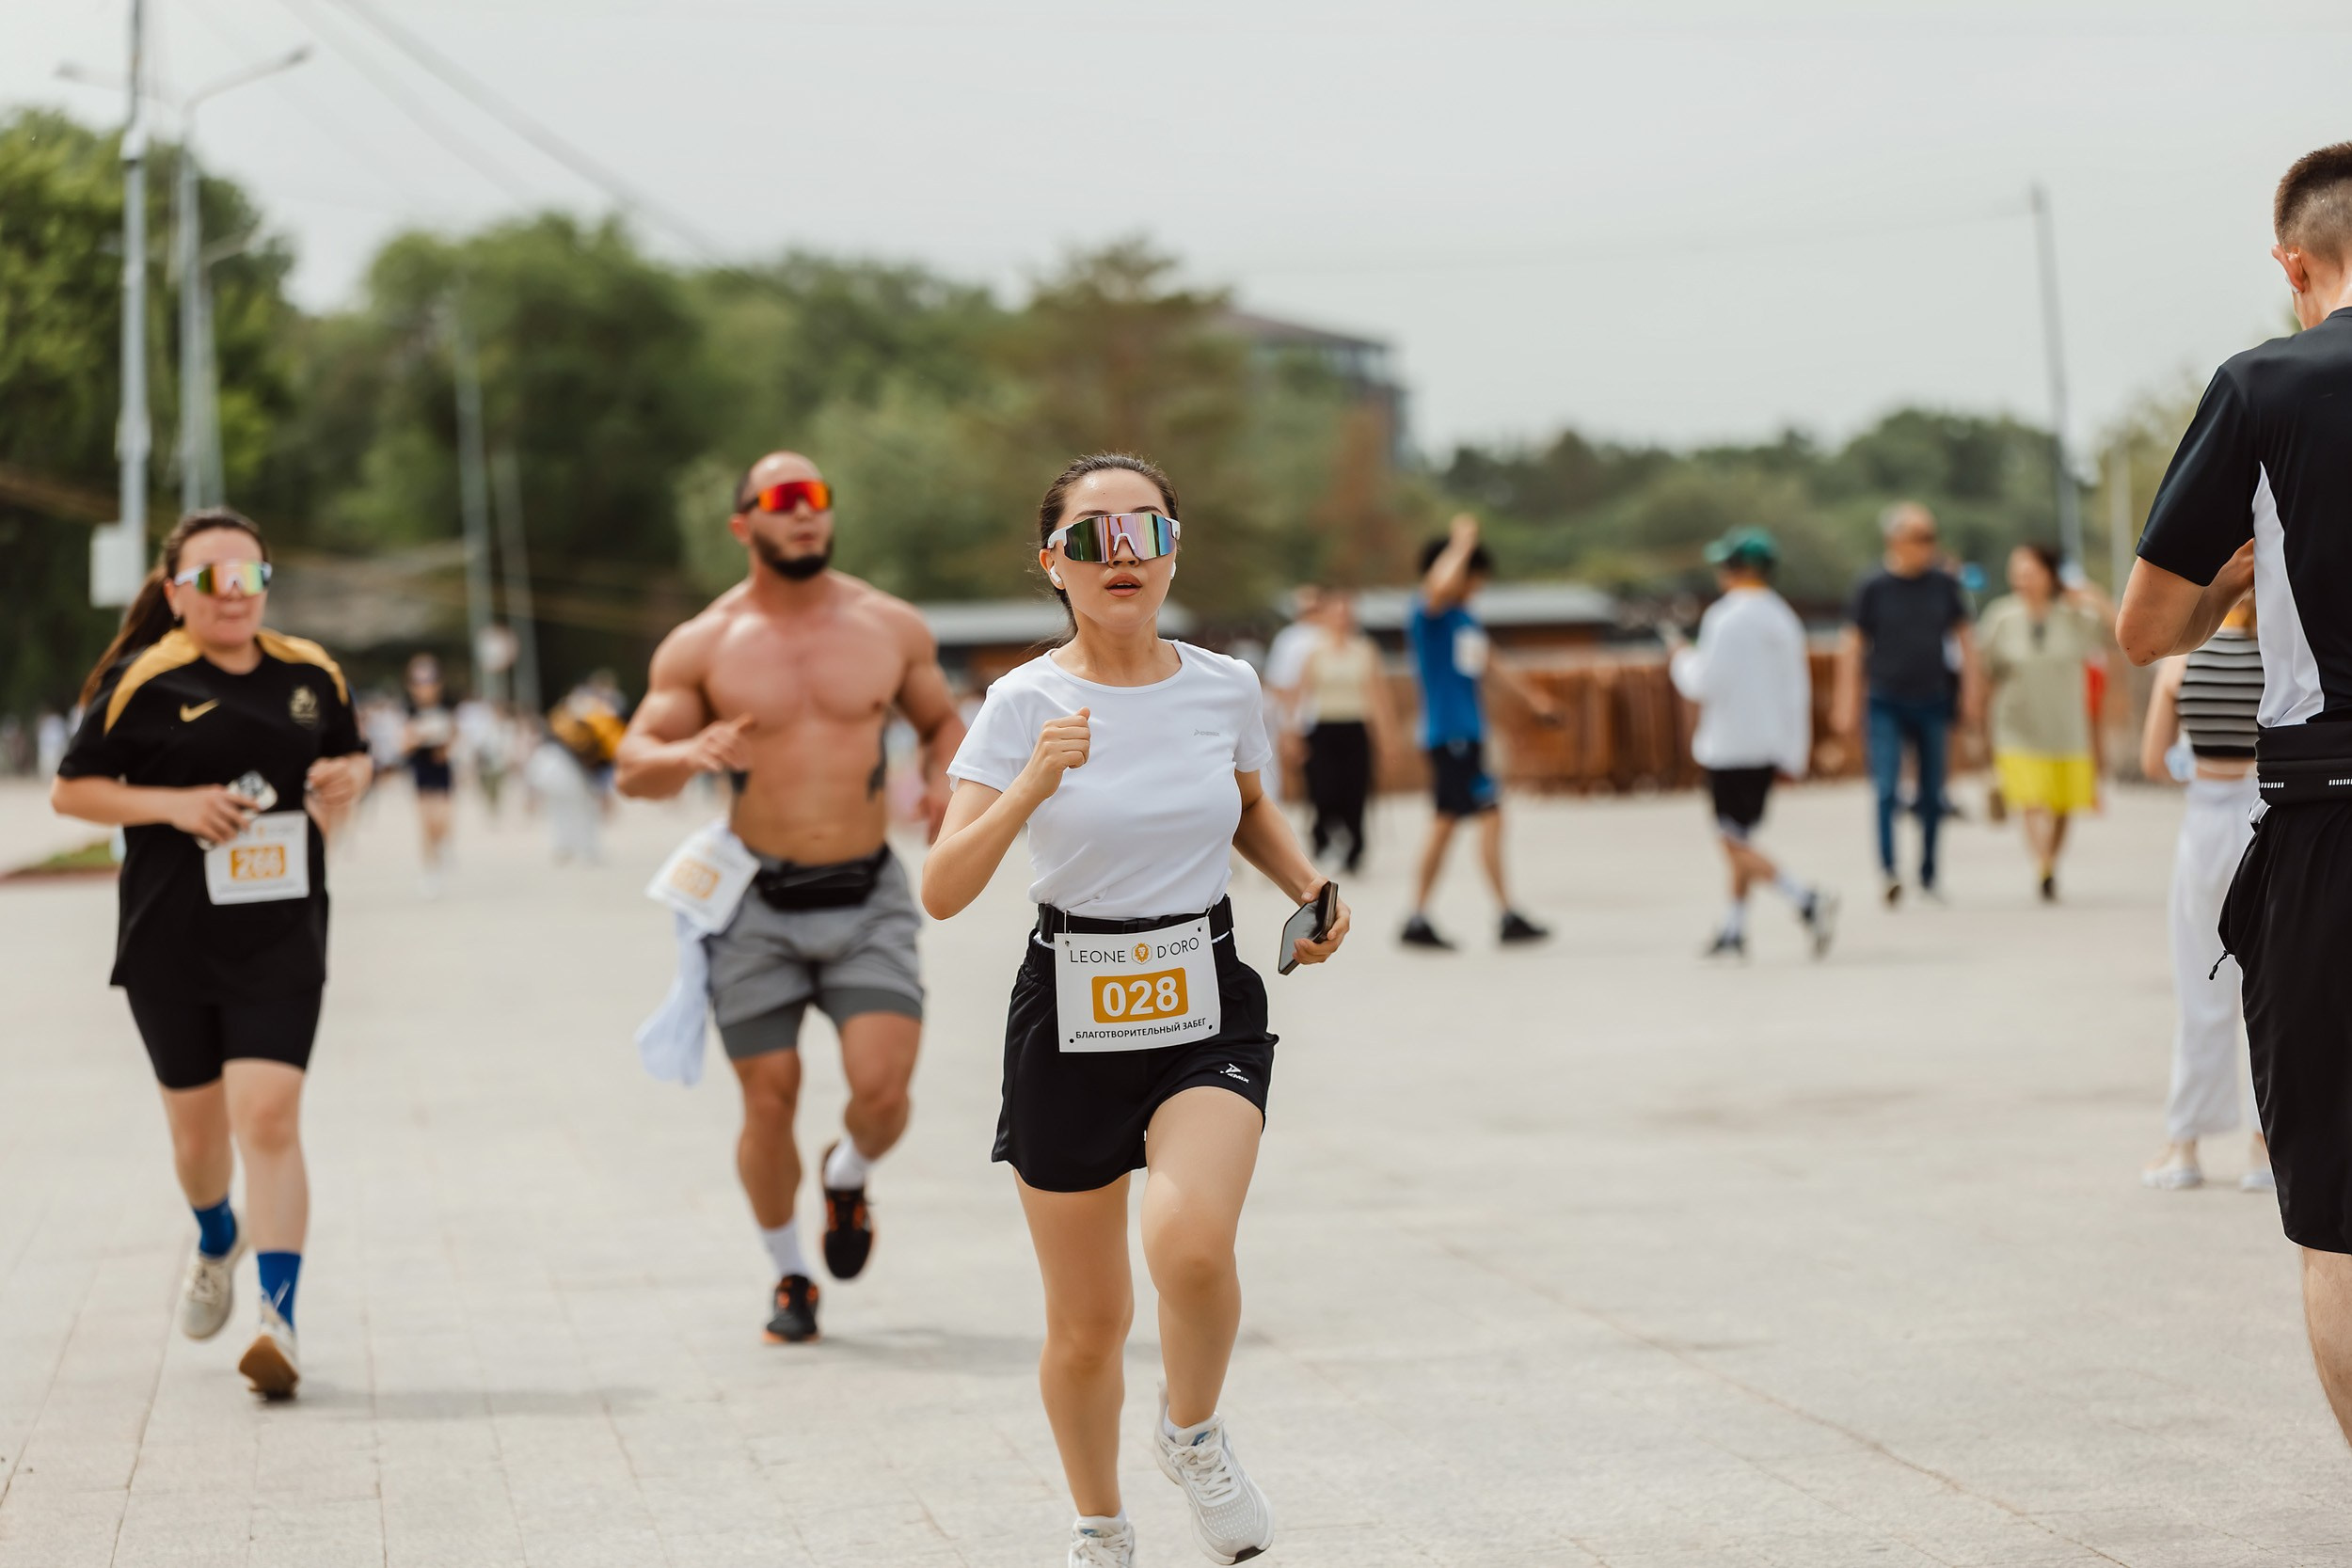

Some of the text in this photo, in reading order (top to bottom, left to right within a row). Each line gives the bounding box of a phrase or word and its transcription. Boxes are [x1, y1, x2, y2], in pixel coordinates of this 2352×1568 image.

[1070, 937, 1200, 963] LEONE D'ORO
[1102, 975, 1179, 1018] 028
[1075, 1017, 1207, 1039] БЛАГОТВОРИТЕЛЬНЫЙ ЗАБЕГ
